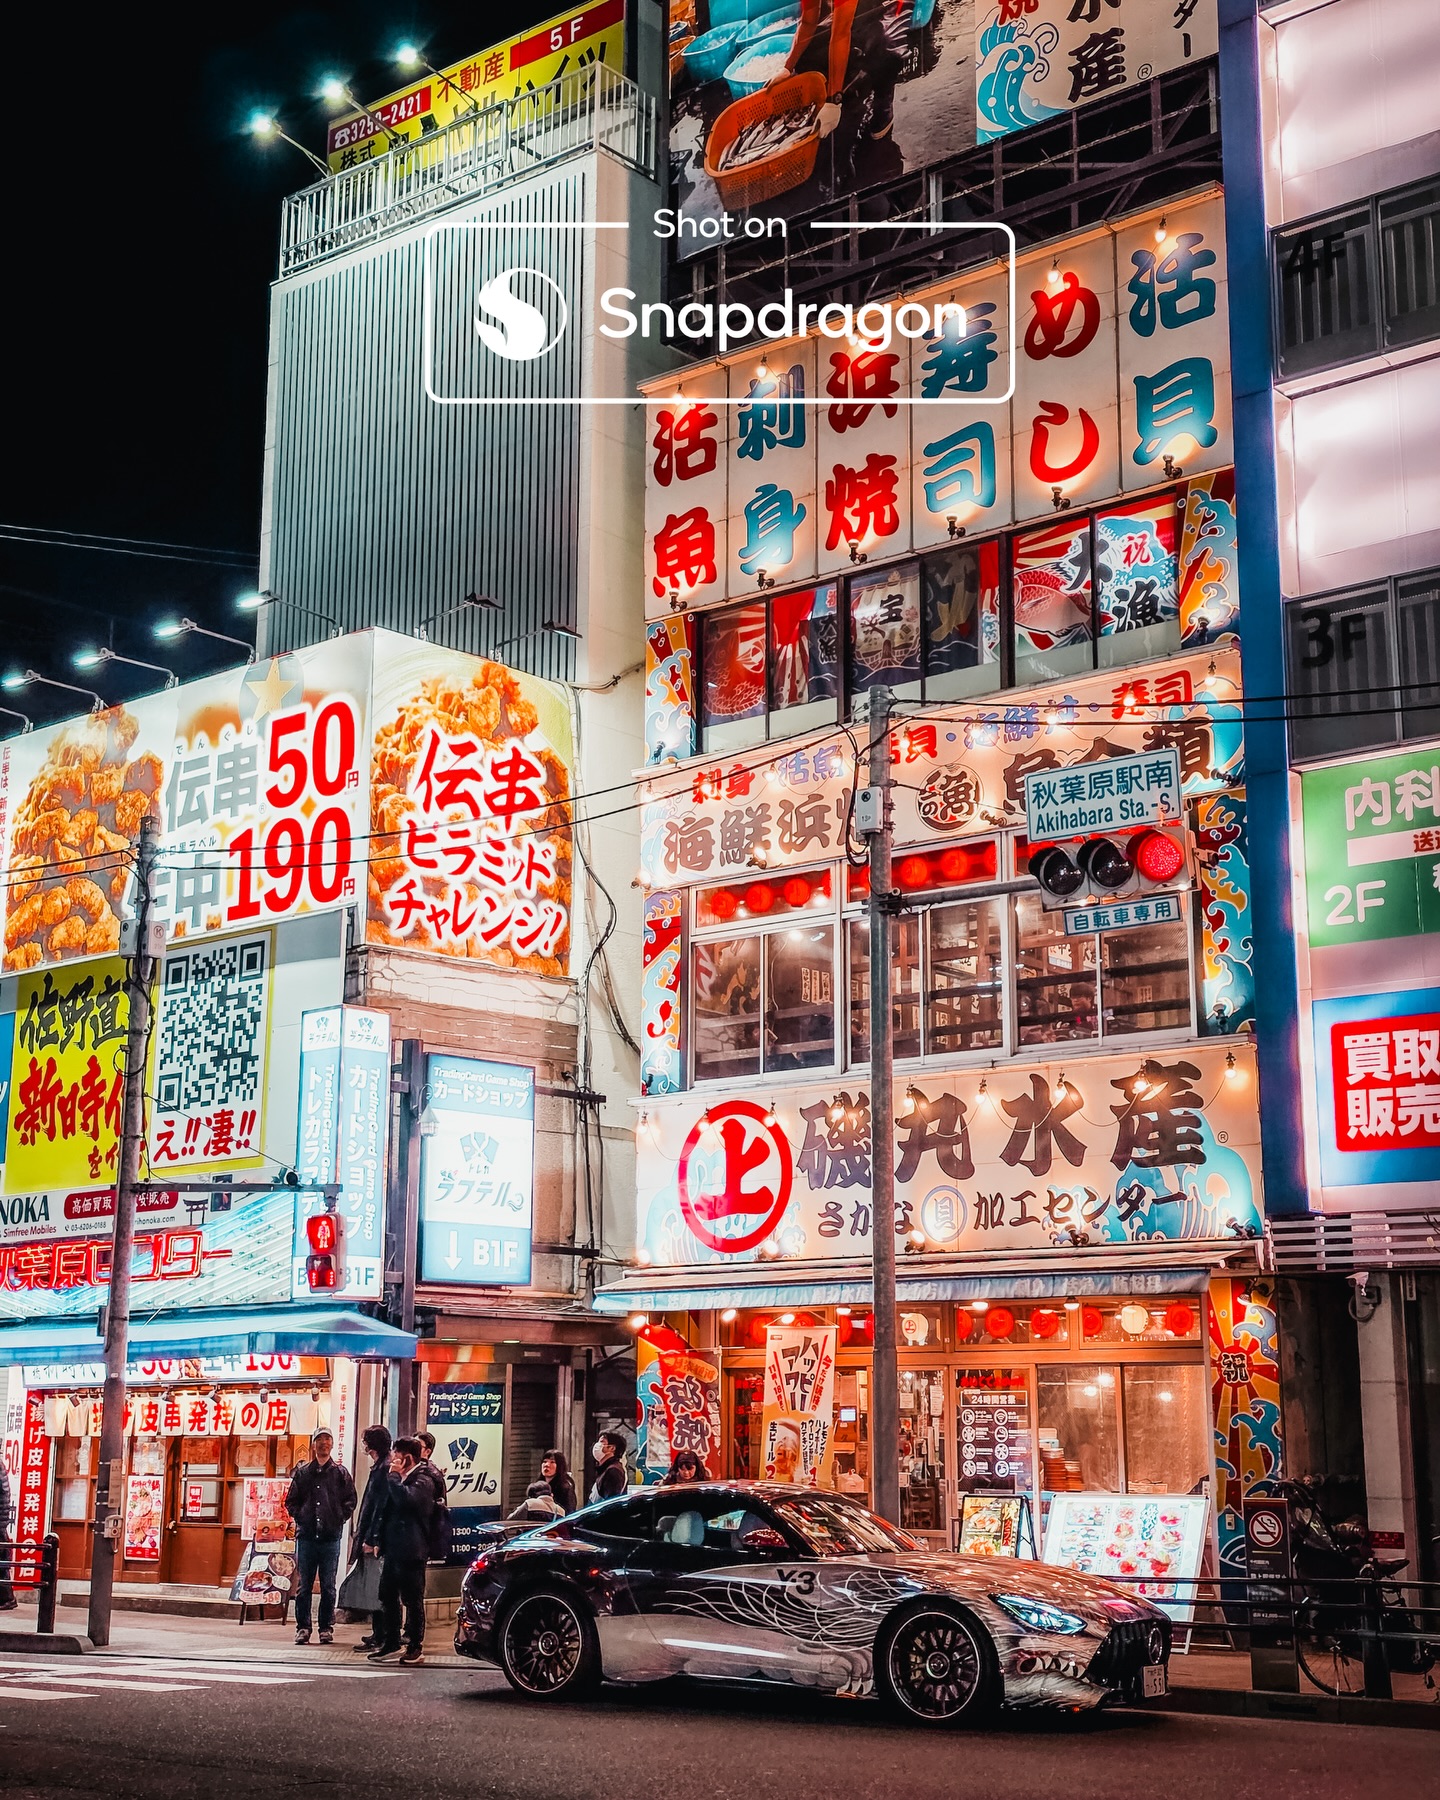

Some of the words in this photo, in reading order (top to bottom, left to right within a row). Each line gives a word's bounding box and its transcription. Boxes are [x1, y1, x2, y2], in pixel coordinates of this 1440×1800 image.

[436, 51, 505, 103] 不動産
[1283, 227, 1345, 287] 4F
[1023, 271, 1101, 484] めし
[1127, 232, 1218, 466] 活貝
[921, 302, 998, 513] 寿司
[737, 364, 807, 576] 刺身
[825, 338, 901, 551] 浜焼
[652, 402, 718, 598] 活魚
[1122, 533, 1151, 568] 祝
[1300, 609, 1367, 669] 3F
[166, 743, 259, 833] 伝串
[265, 701, 356, 809] 50
[413, 728, 542, 831] 伝串
[1031, 760, 1174, 810] 秋葉原駅南
[1035, 808, 1115, 835] Akihabara
[1345, 766, 1440, 832] 内科
[227, 807, 352, 921] 190
[406, 819, 553, 891] ピラミッド
[1072, 900, 1173, 932] 自転車専用
[1323, 879, 1387, 926] 2F
[485, 1072, 508, 1086] Game
[508, 1076, 530, 1089] Shop
[1343, 1029, 1440, 1086] 買取
[434, 1081, 530, 1110] カードショップ
[1346, 1083, 1440, 1140] 販売
[347, 1064, 368, 1240] カードショップ
[797, 1059, 1207, 1191] 磯丸水産
[3, 1226, 29, 1238] Simfree
[29, 1224, 57, 1236] Mobiles
[973, 1182, 1188, 1232] 加工センター
[473, 1238, 519, 1269] B1F
[486, 1393, 501, 1401] Shop
[781, 1345, 801, 1411] アワー
[800, 1336, 819, 1411] ハッピー
[1221, 1353, 1249, 1384] 祝
[429, 1402, 501, 1417] カードショップ
[971, 1395, 1016, 1405] 24時間営業
[454, 1461, 471, 1470] トレカ
[767, 1421, 778, 1462] 生ビール
